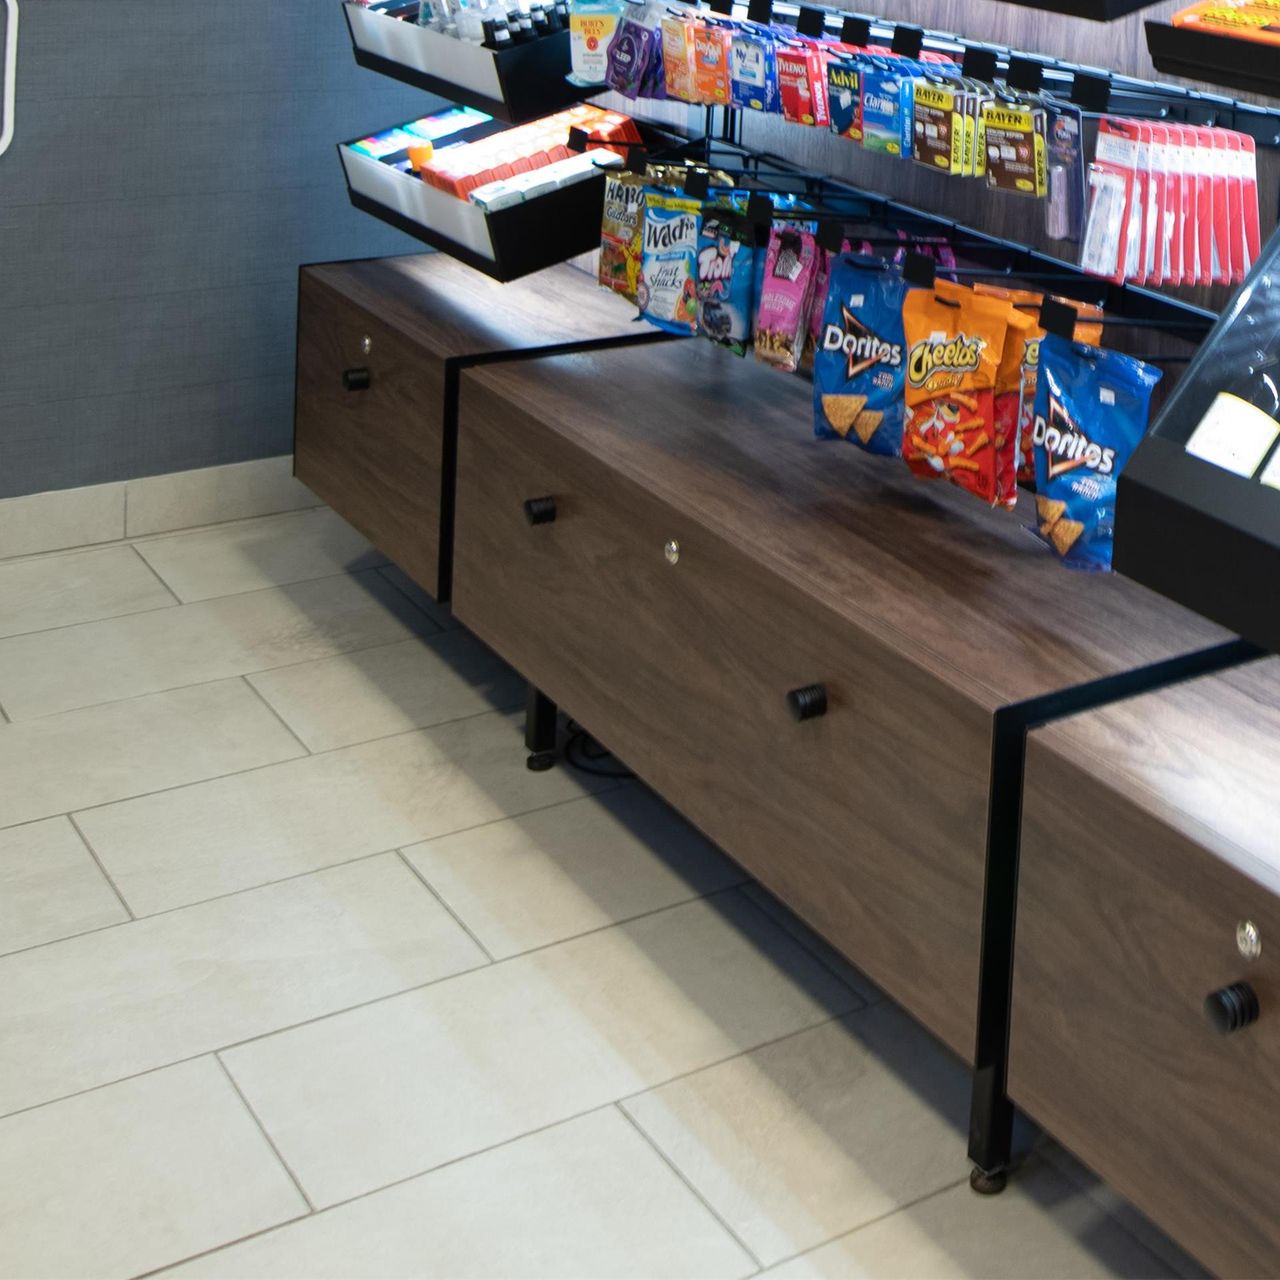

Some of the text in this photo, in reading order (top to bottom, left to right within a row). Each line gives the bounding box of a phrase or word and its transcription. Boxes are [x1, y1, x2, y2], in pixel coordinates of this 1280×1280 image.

[777, 59, 807, 74] TYLENOL
[830, 69, 859, 90] Advil
[915, 86, 945, 103] BAYER
[985, 109, 1023, 125] BAYER
[823, 323, 902, 367] Doritos
[909, 333, 979, 384] Cheetos
[1033, 414, 1116, 475] Doritos
